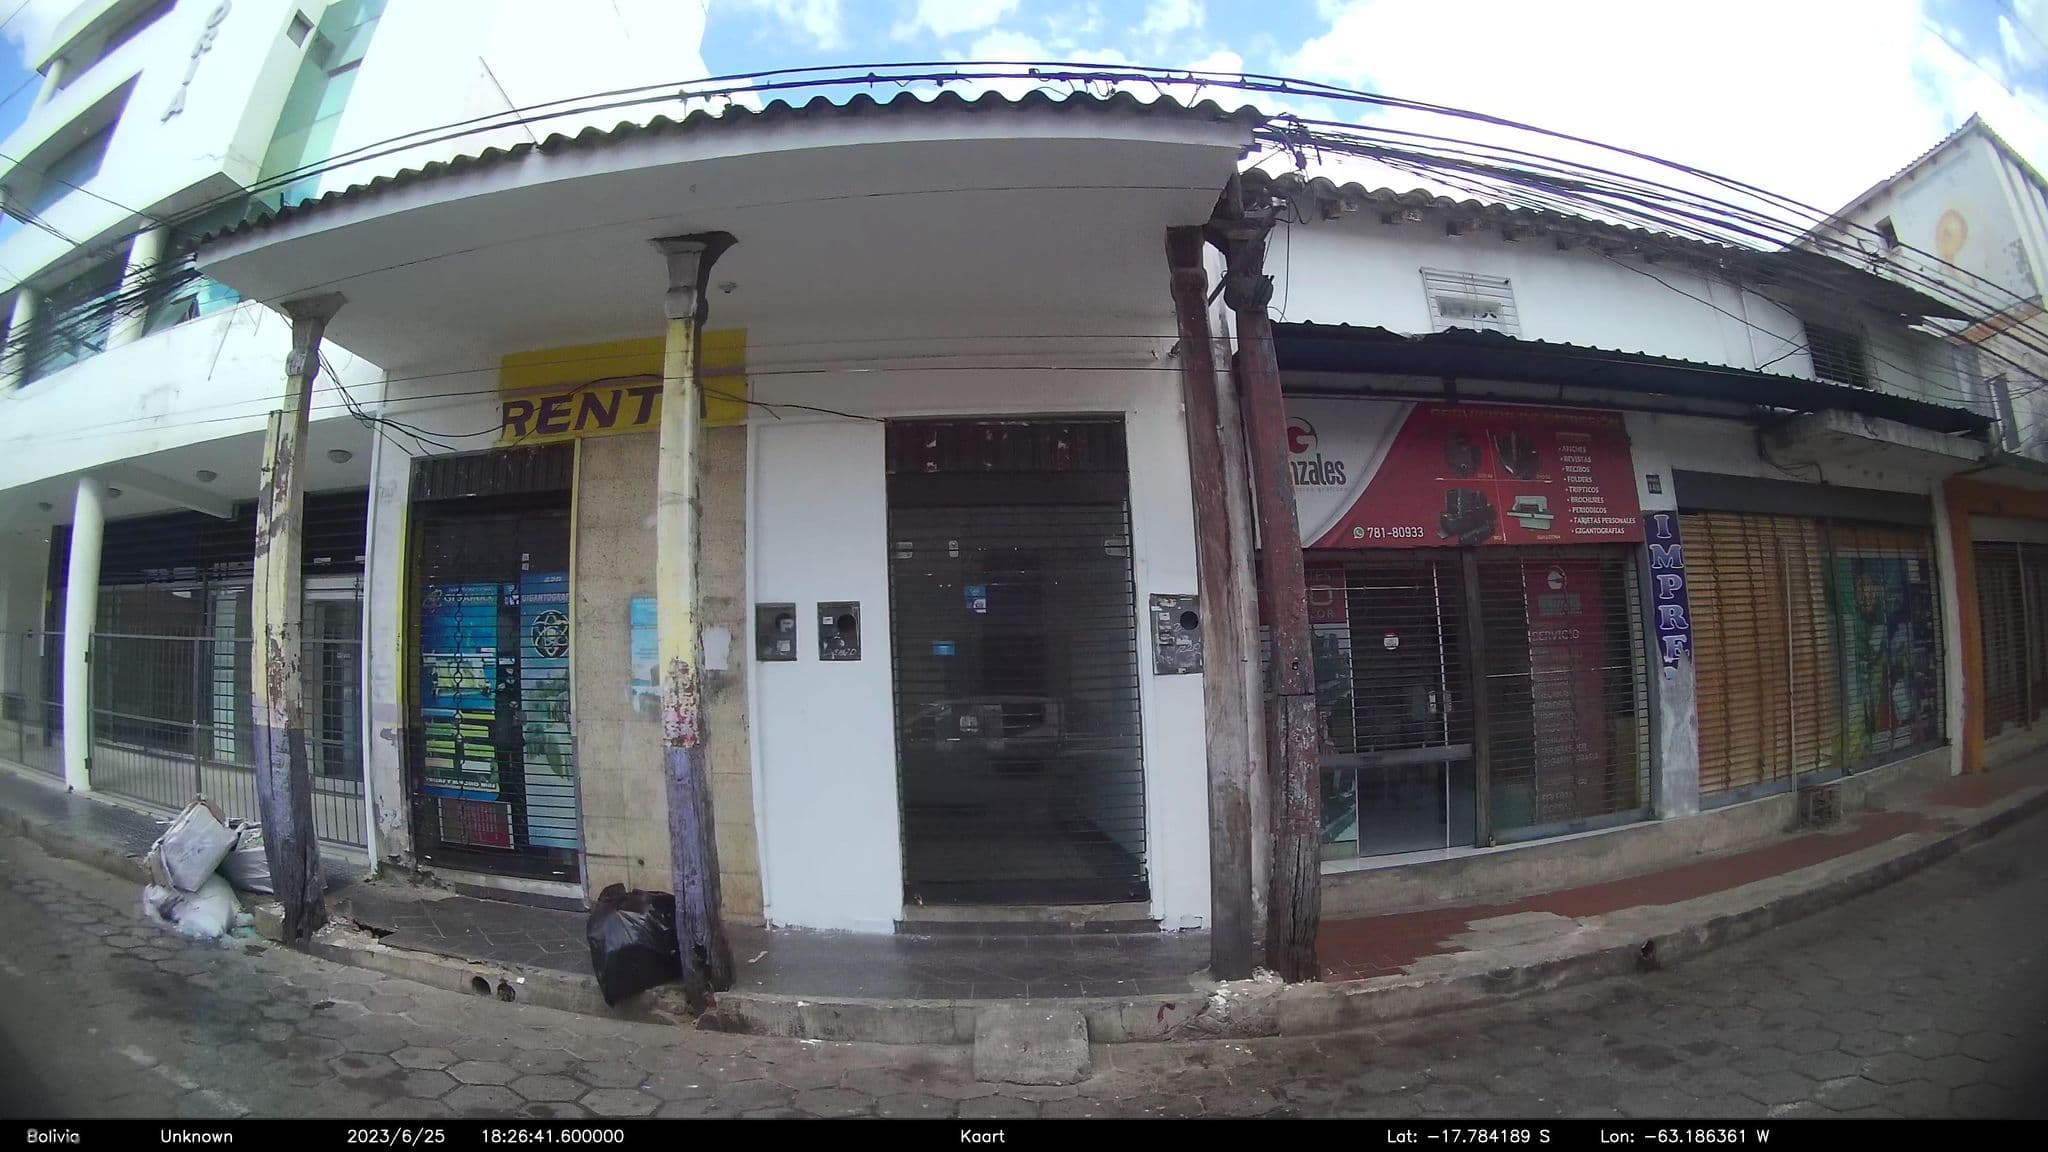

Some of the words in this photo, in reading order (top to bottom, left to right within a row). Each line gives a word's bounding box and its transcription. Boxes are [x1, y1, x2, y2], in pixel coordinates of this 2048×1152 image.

[501, 385, 707, 440] RENT
[1291, 453, 1347, 486] nzales
[1565, 465, 1590, 473] RECIBOS
[1570, 496, 1605, 504] BROCHURES
[1367, 526, 1424, 538] 781-80933
